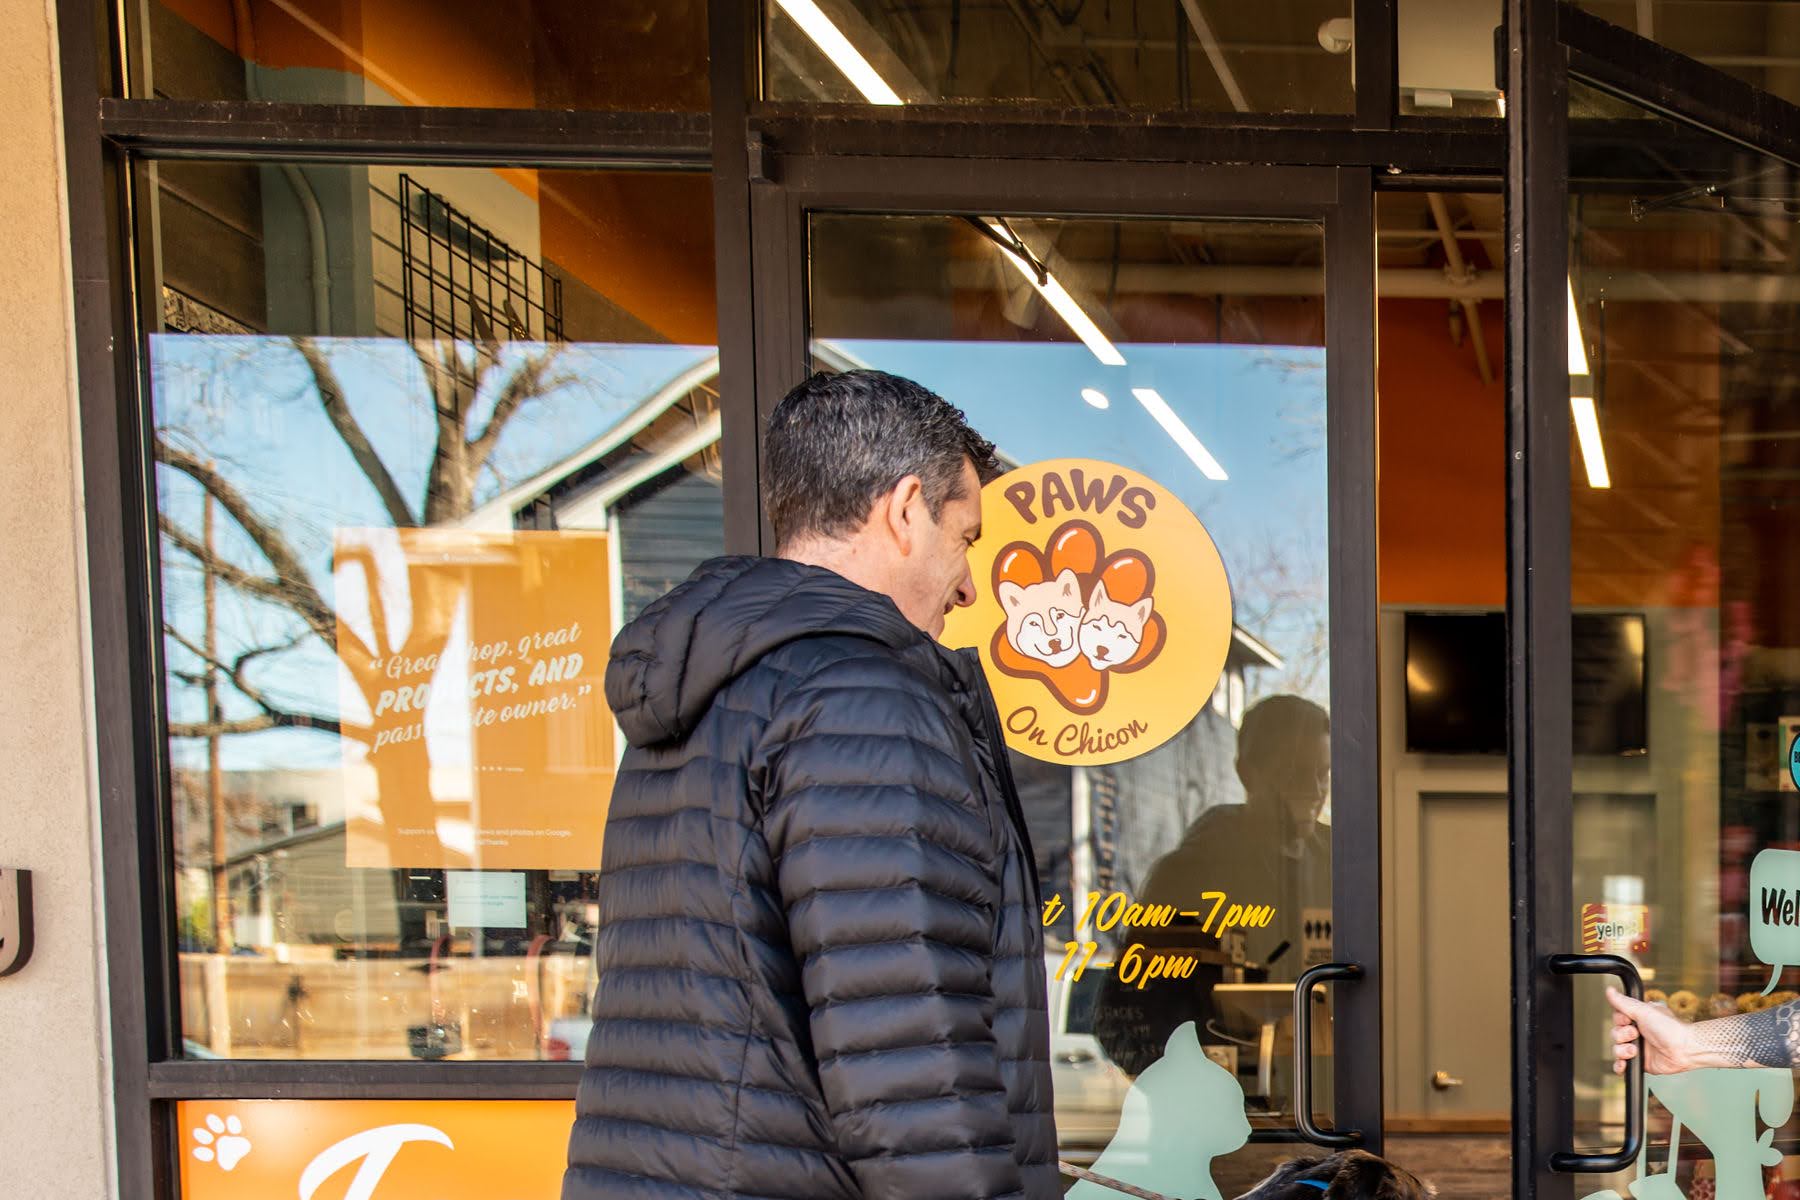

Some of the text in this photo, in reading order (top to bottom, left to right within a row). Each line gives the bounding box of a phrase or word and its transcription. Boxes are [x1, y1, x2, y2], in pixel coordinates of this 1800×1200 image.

[1004, 468, 1156, 529] PAWS
[369, 648, 447, 680] “Grea
[518, 622, 582, 660] great
[375, 653, 584, 717] PROCTS, AND
[1006, 706, 1148, 757] On Chicon
[1076, 891, 1276, 939] 10am-7pm
[1596, 921, 1625, 941] yelp
[1055, 941, 1199, 990] 11-6pm
